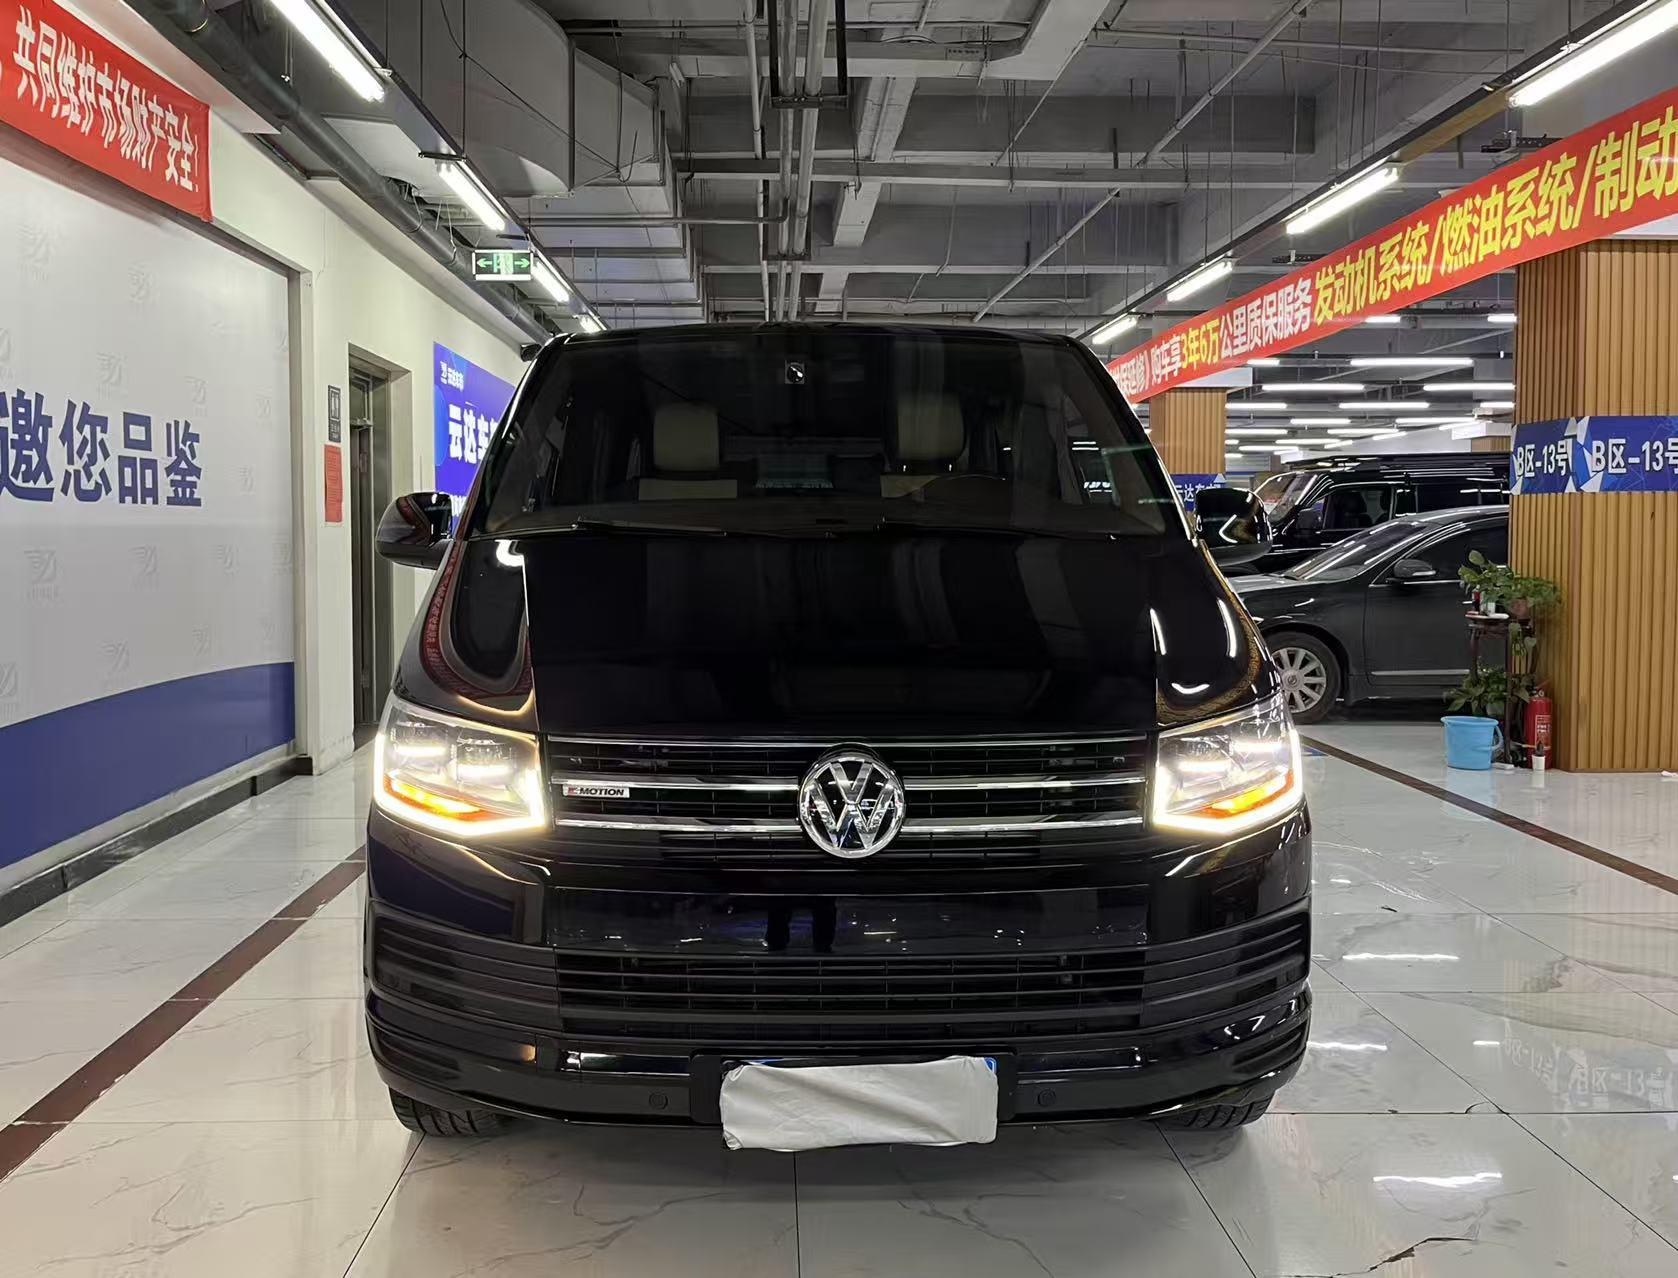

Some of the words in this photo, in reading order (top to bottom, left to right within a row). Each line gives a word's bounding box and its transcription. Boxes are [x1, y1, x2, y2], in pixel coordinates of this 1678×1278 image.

[0, 387, 202, 507] 邀您品鉴
[1516, 440, 1569, 478] B区-13号
[1591, 437, 1678, 475] B区-13号
